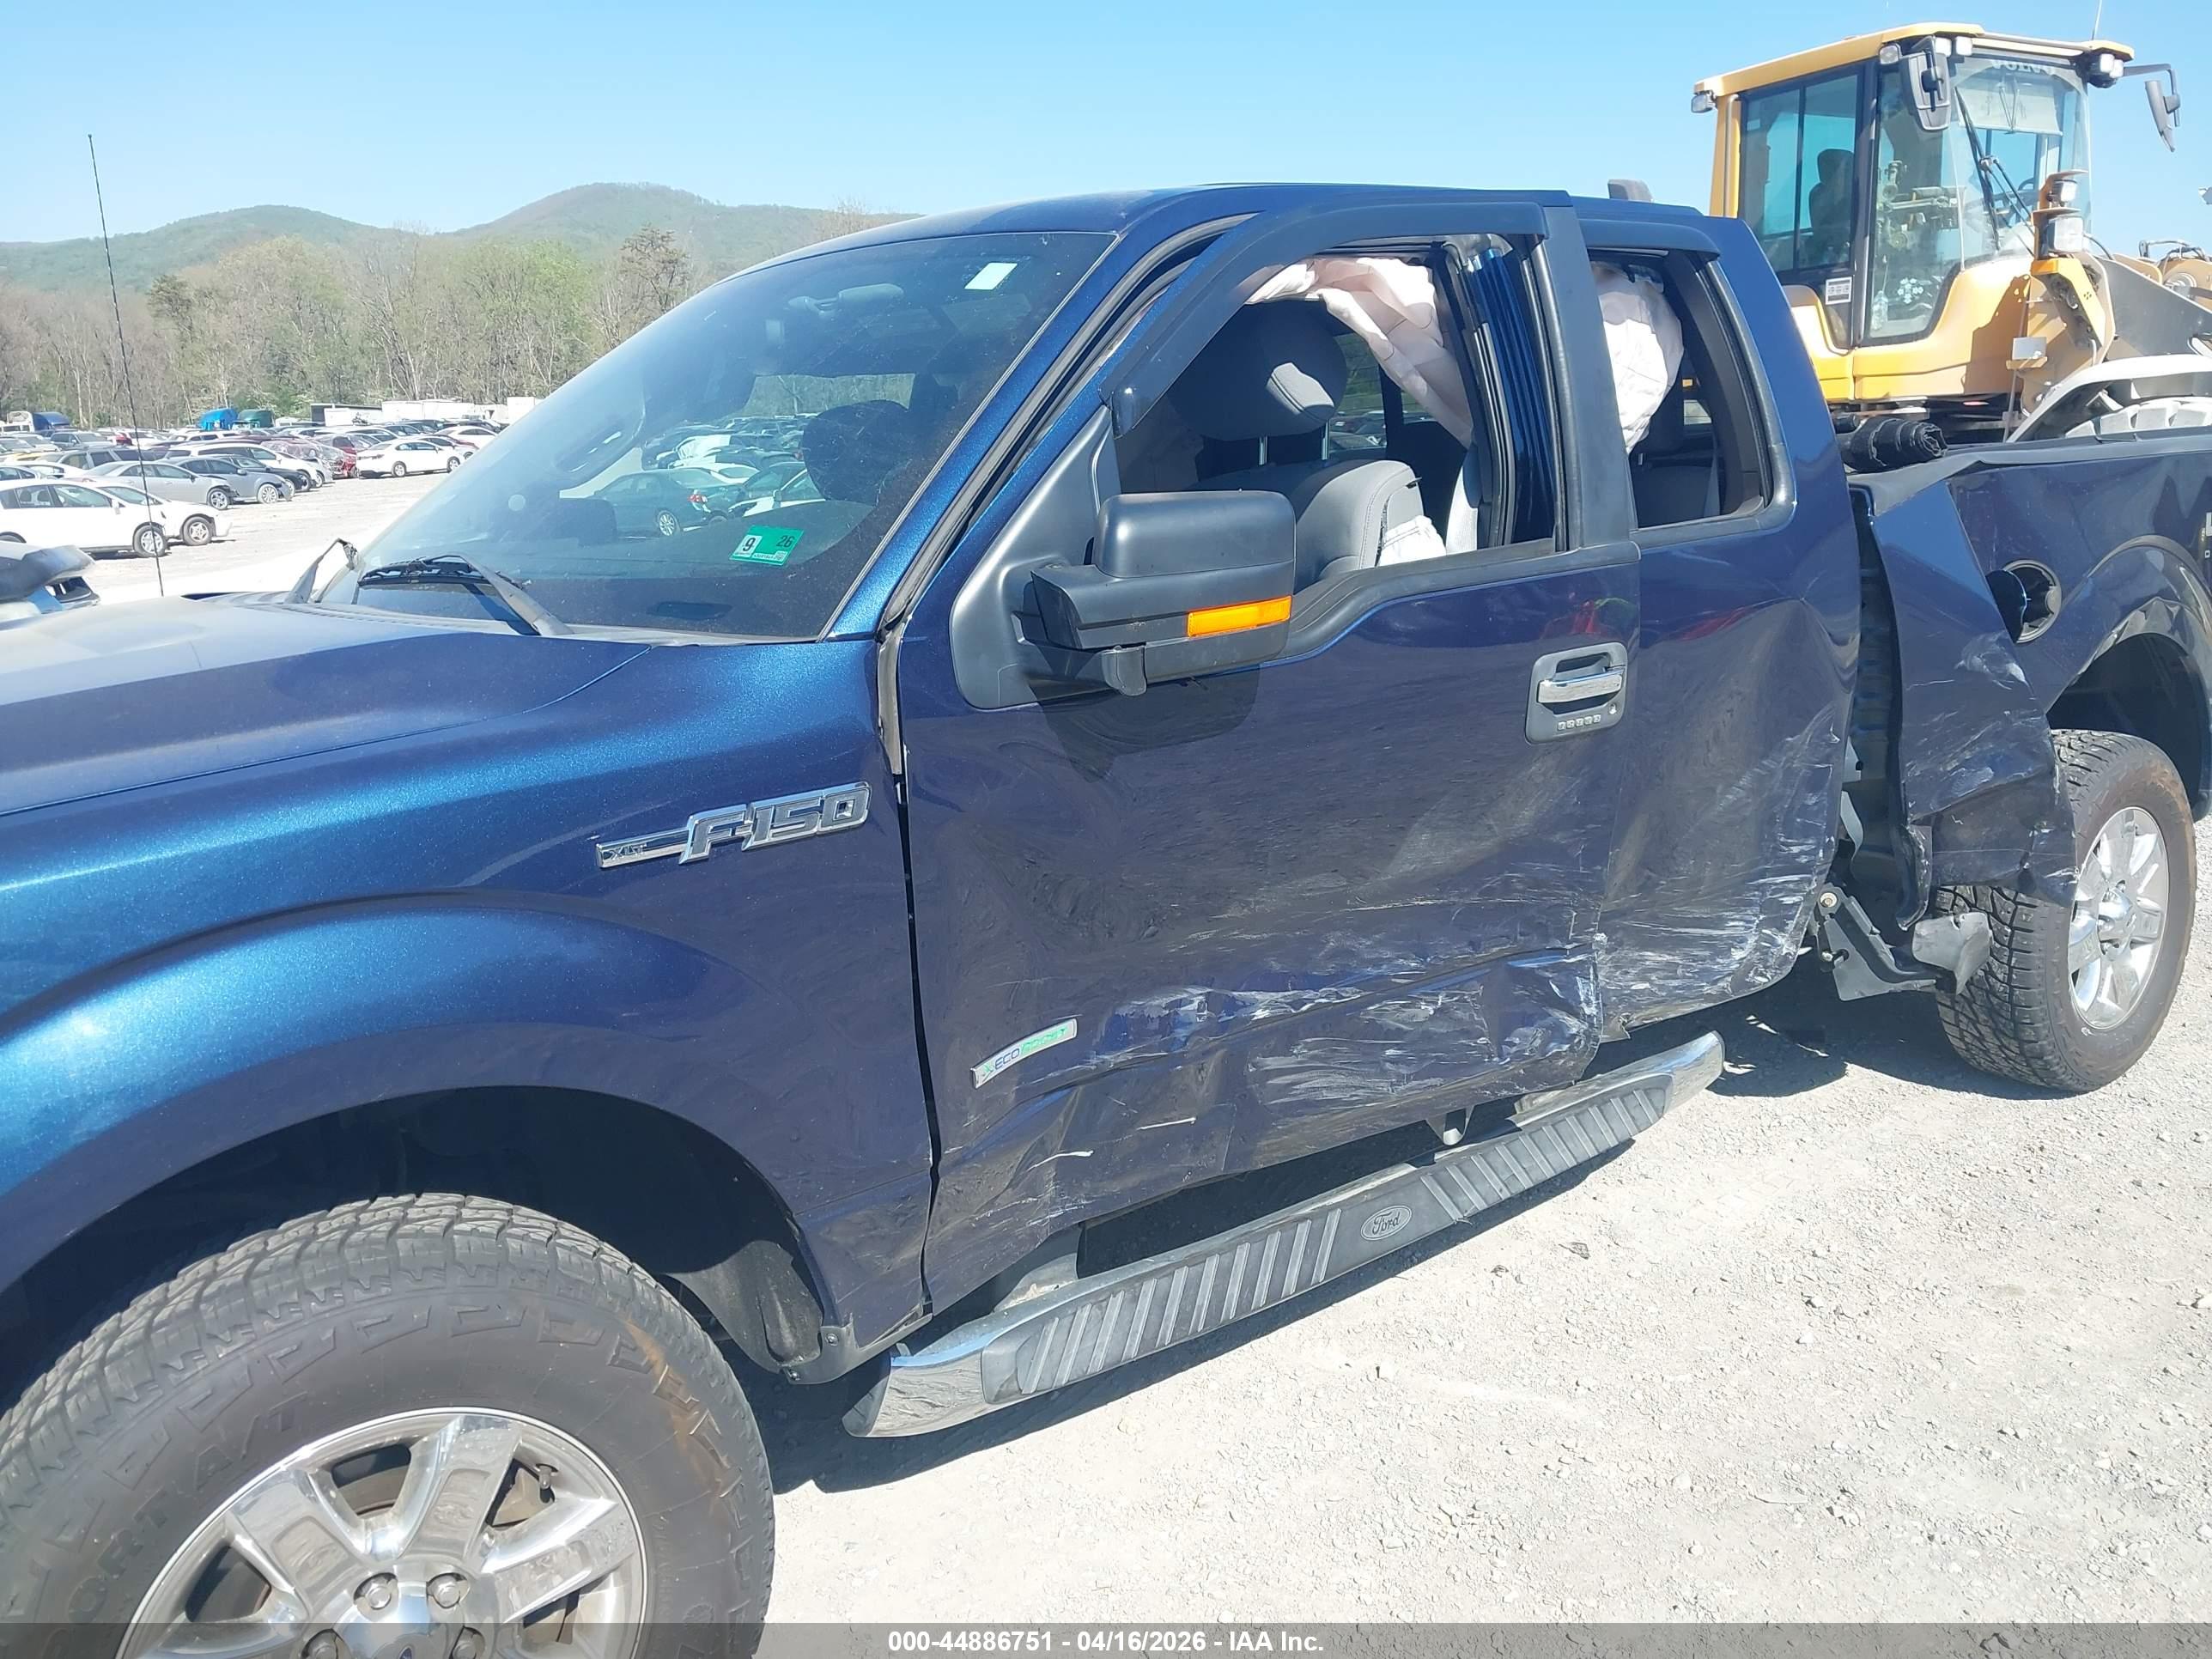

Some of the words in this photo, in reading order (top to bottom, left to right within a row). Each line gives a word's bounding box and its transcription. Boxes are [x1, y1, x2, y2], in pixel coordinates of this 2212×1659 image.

[743, 538, 756, 551] 9
[775, 535, 795, 548] 26
[678, 781, 872, 865] F-150
[609, 842, 648, 861] XLT
[1371, 1211, 1401, 1236] Ford
